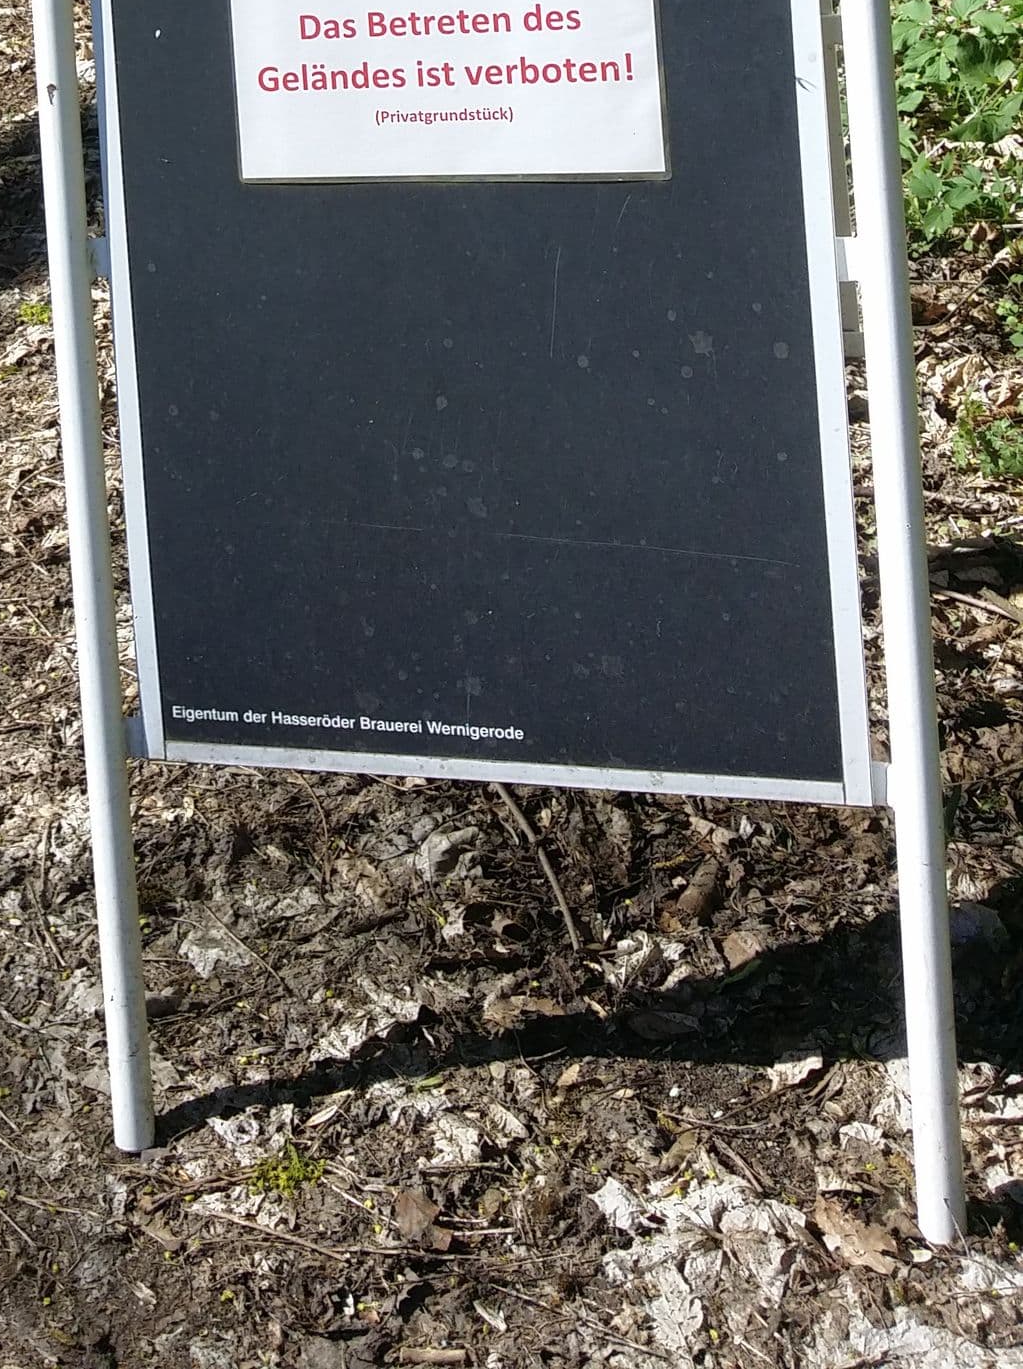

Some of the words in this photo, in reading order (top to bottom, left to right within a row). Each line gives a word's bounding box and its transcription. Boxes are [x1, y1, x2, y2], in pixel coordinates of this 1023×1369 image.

[299, 14, 357, 40] Das
[367, 8, 512, 37] Betreten
[523, 3, 581, 31] des
[257, 62, 406, 92] Geländes
[416, 60, 455, 88] ist
[464, 52, 634, 87] verboten!
[374, 106, 514, 125] (Privatgrundstück)
[172, 705, 239, 723] Eigentum
[243, 710, 267, 724] der
[271, 711, 355, 730] Hasseröder
[360, 716, 423, 734] Brauerei
[426, 721, 525, 741] Wernigerode
